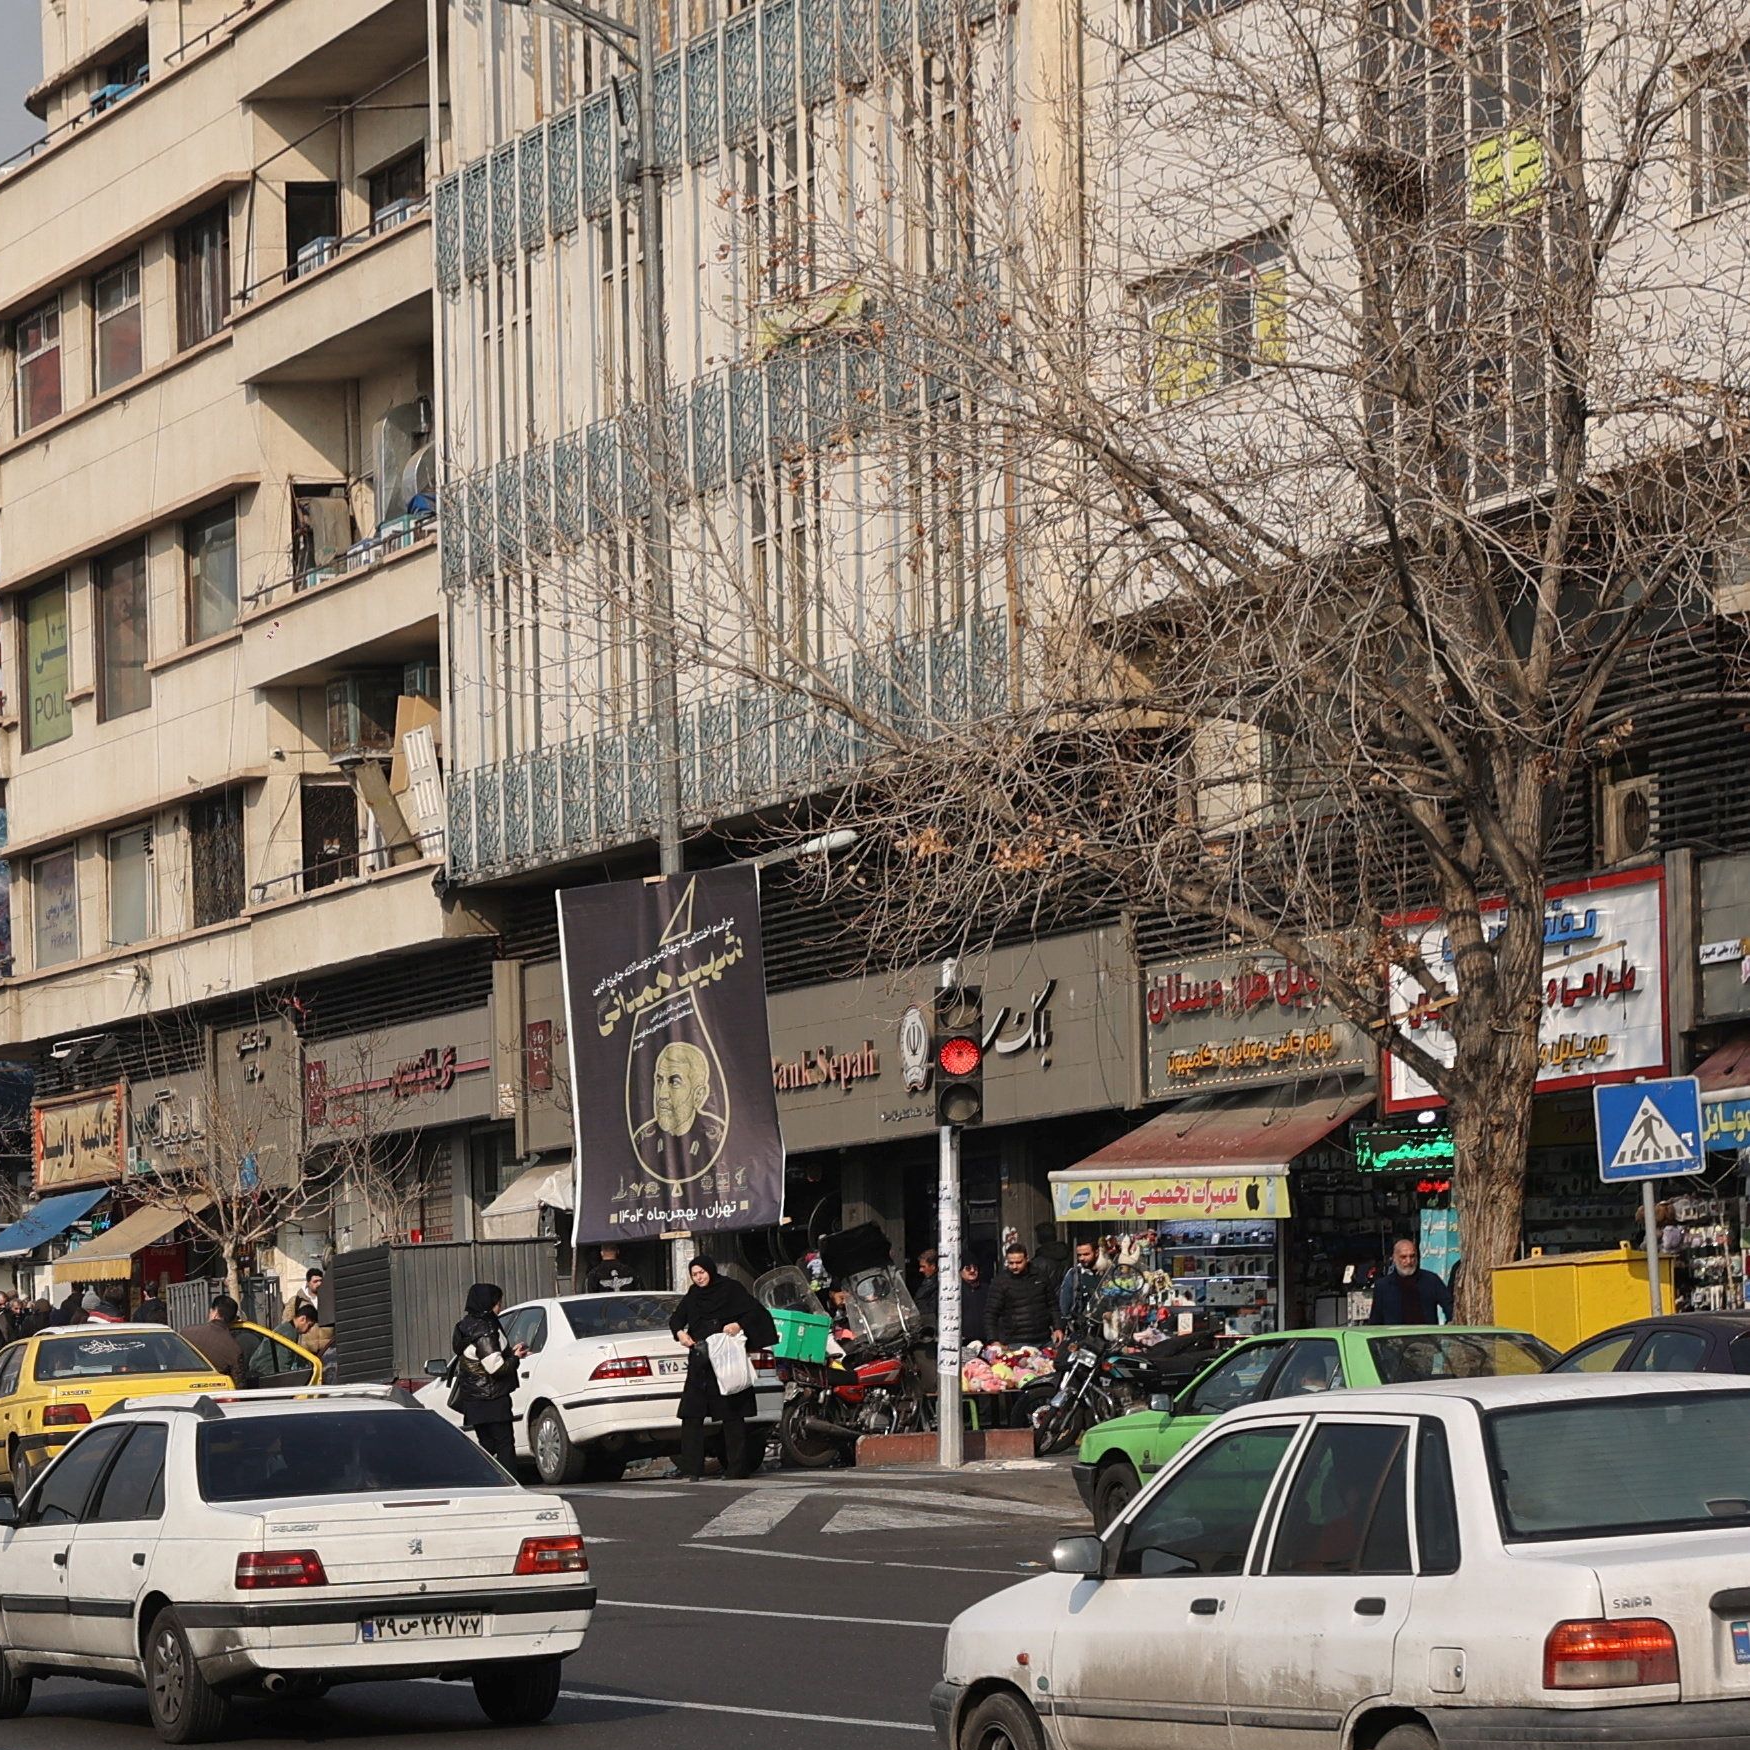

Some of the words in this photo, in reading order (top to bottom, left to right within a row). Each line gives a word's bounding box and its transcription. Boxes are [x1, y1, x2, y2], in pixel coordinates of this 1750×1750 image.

[34, 692, 71, 724] POLI
[678, 931, 743, 988] شهید
[1562, 959, 1637, 1008] طراحی
[598, 970, 672, 1037] همدانی
[996, 979, 1055, 1068] بانک
[1166, 1043, 1214, 1076] کامپیوتر
[1226, 1037, 1266, 1067] موبایل
[1267, 1029, 1304, 1061] جانبی
[1553, 1033, 1609, 1073] موبایل
[817, 1041, 879, 1090] Sepah
[1092, 1182, 1135, 1215] موبایل
[1136, 1180, 1191, 1215] تخصصی
[1192, 1177, 1240, 1214] تعمیرات
[619, 1208, 644, 1224] ۱۴۰۴
[270, 1523, 320, 1533] PEUGEOT
[535, 1511, 560, 1521] 405
[1612, 1596, 1652, 1610] SAIPA
